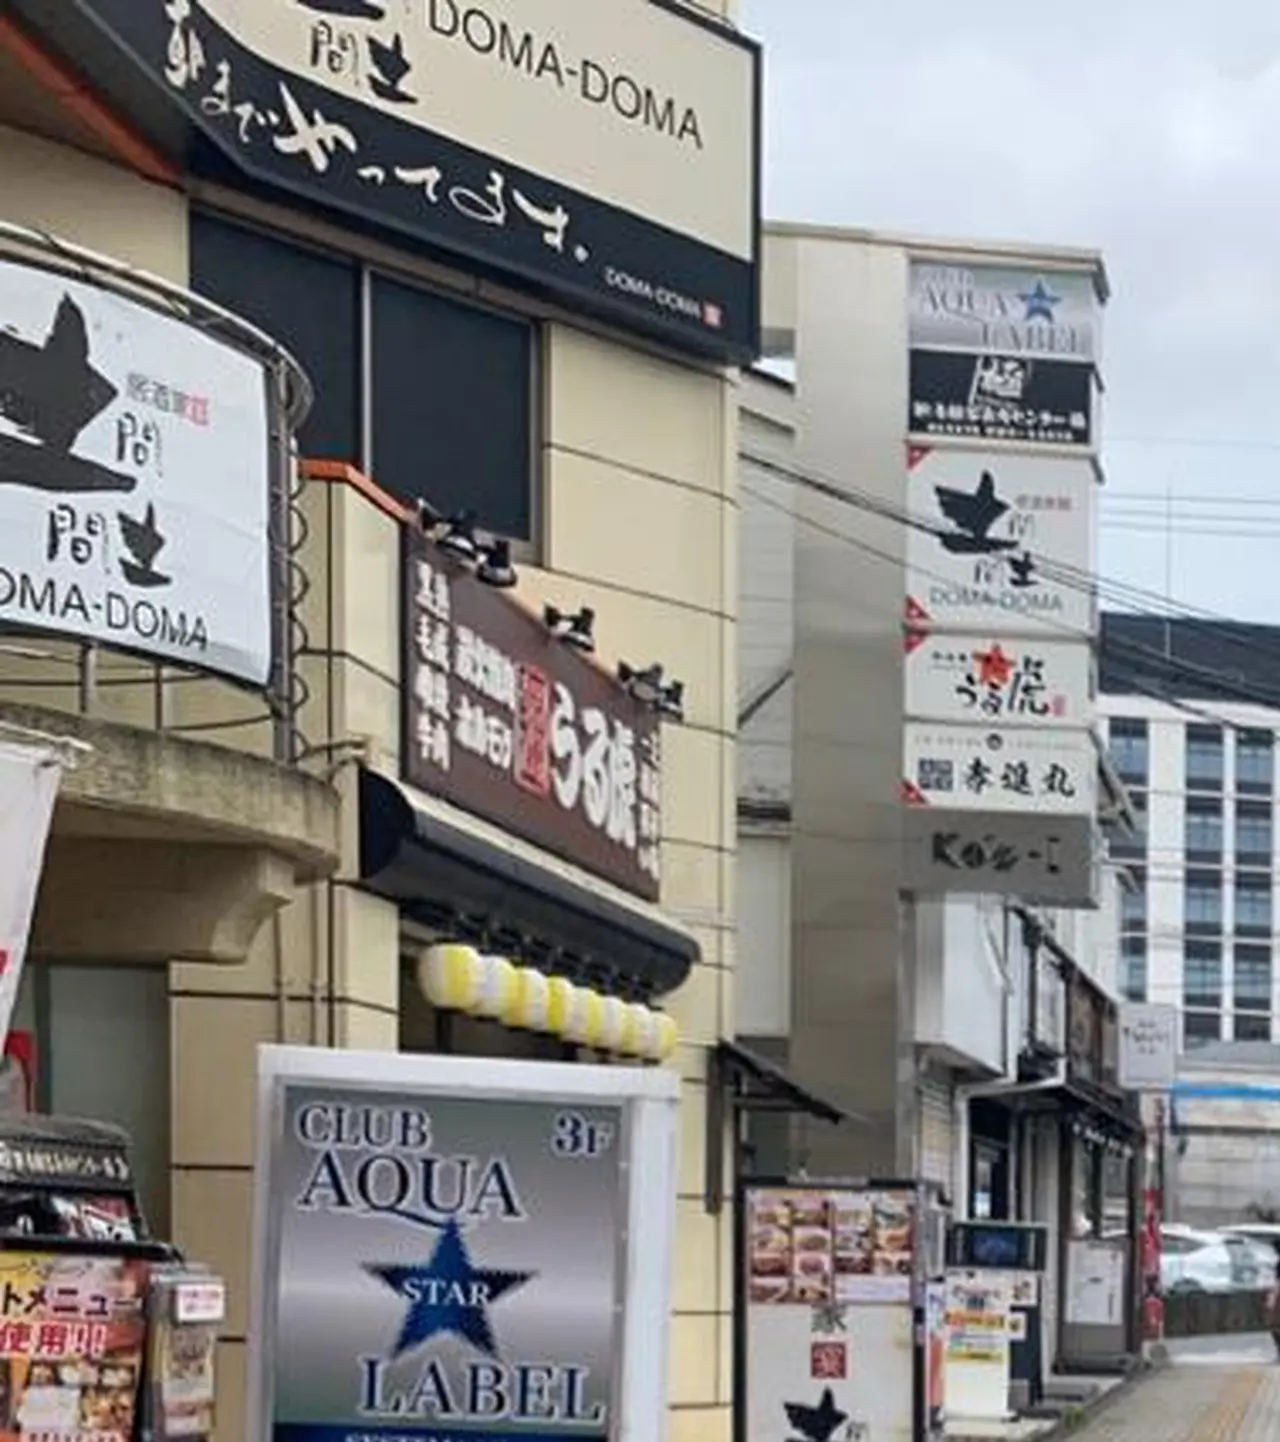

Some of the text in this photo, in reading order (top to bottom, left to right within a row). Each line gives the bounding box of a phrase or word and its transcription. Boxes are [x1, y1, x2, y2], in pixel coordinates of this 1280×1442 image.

[428, 0, 704, 150] DOMA-DOMA
[299, 1104, 616, 1157] CLUB 3F
[298, 1152, 522, 1229] AQUA
[402, 1278, 492, 1306] STAR
[360, 1358, 604, 1421] LABEL
